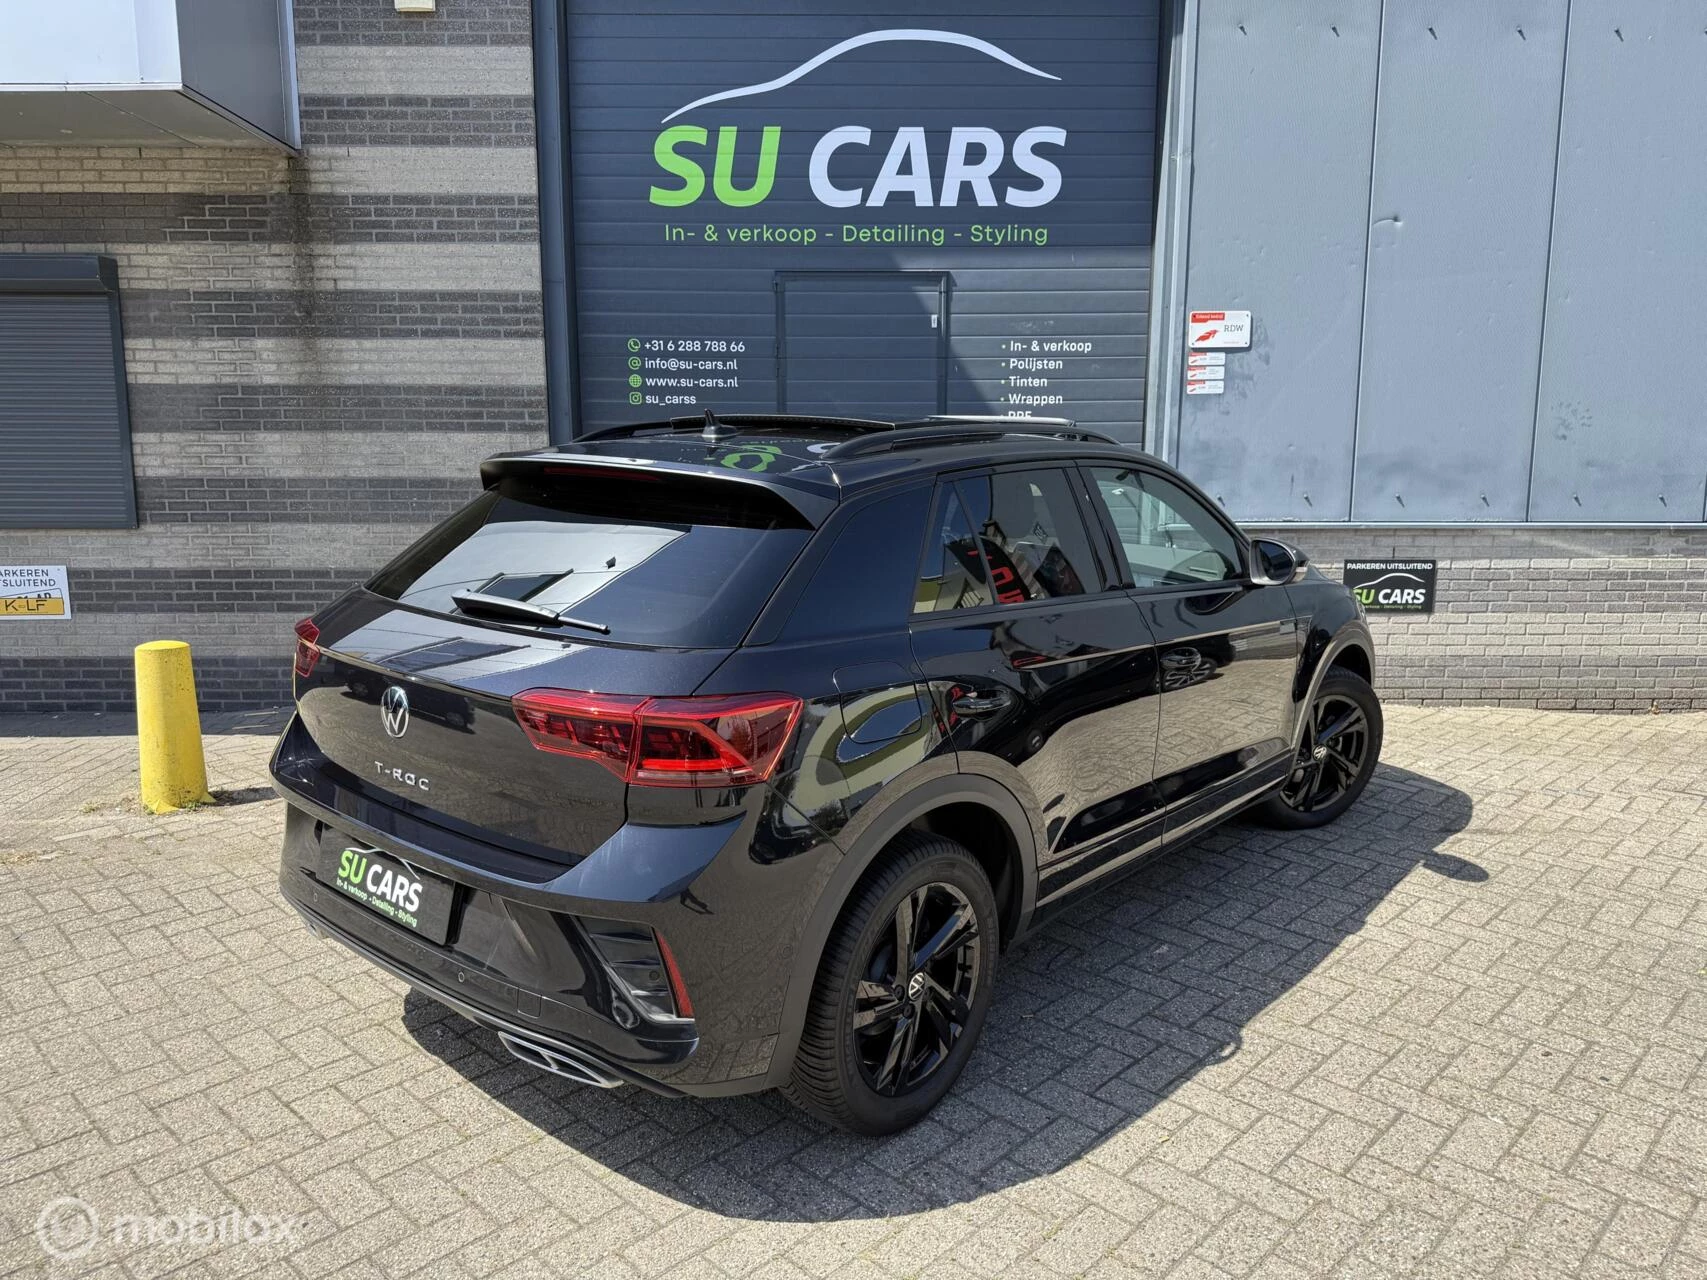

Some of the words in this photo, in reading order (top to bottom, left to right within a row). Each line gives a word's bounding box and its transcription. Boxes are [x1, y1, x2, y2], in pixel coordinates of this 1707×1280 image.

[649, 125, 781, 207] SU
[808, 126, 1067, 208] CARS
[665, 224, 696, 241] In-
[704, 224, 719, 241] &
[727, 224, 817, 245] verkoop
[843, 224, 945, 246] Detailing
[970, 224, 1048, 246] Styling
[1223, 324, 1244, 332] RDW
[644, 340, 664, 351] +31
[667, 340, 675, 351] 6
[678, 340, 701, 352] 288
[704, 340, 727, 352] 788
[730, 341, 745, 352] 66
[1010, 340, 1027, 352] In-
[1031, 340, 1040, 351] &
[1043, 340, 1092, 354] verkoop
[645, 357, 738, 371] info@su-cars.nl
[1009, 358, 1063, 372] Polijsten
[645, 376, 739, 388] www.su-cars.nl
[1009, 375, 1048, 387] Tinten
[645, 394, 697, 406] su_carss
[1008, 393, 1063, 407] Wrappen
[1346, 562, 1386, 570] PARKEREN
[1387, 562, 1433, 570] UITSLUITEND
[1378, 588, 1426, 604] CARS
[374, 760, 431, 791] T-ROC
[338, 850, 367, 884] SU
[366, 864, 423, 912] CARS
[348, 884, 368, 901] verkoop
[372, 896, 395, 916] Detailing
[398, 909, 417, 928] Styling
